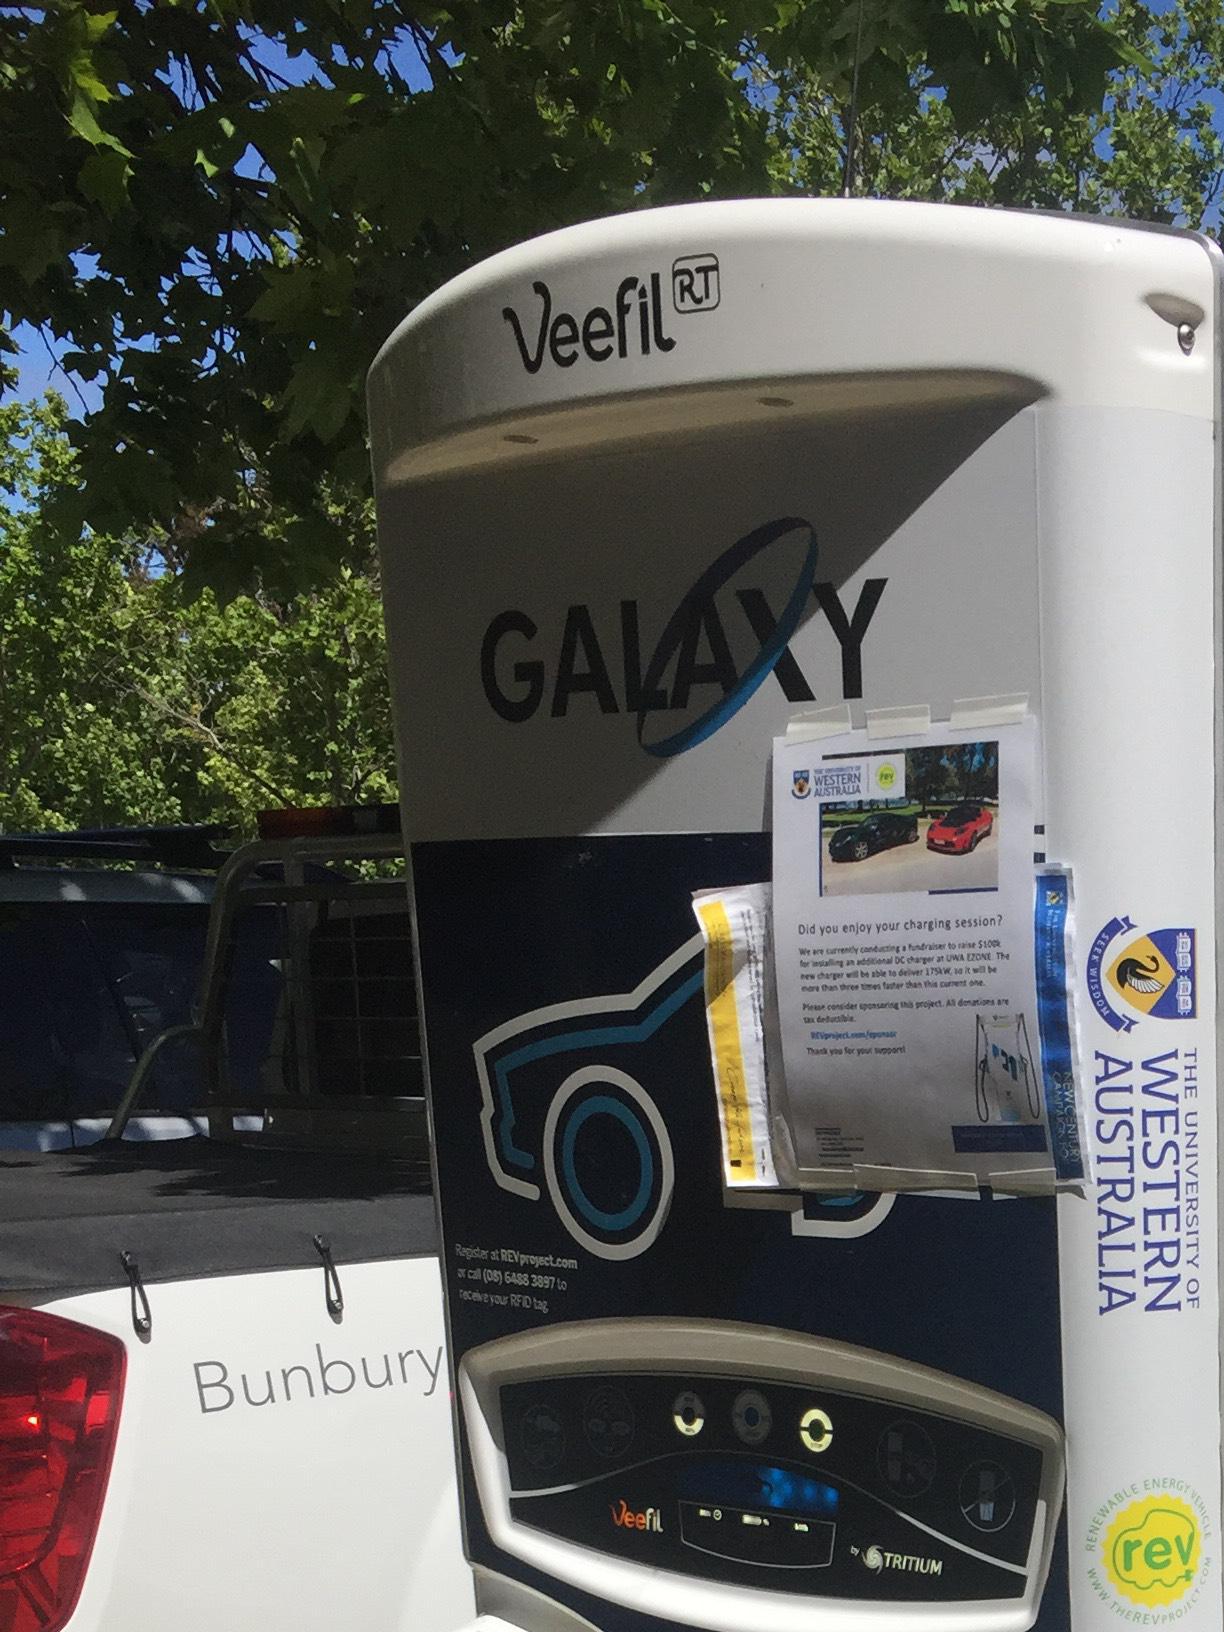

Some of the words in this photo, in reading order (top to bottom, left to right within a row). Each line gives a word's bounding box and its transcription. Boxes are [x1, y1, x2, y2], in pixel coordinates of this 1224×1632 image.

[502, 272, 677, 374] Veefil
[673, 264, 719, 305] RT
[480, 577, 889, 723] GALAXY
[814, 772, 861, 786] WESTERN
[814, 785, 861, 798] AUSTRALIA
[799, 923, 816, 935] Did
[820, 925, 838, 937] you
[842, 923, 872, 936] enjoy
[876, 922, 900, 935] your
[904, 918, 951, 932] charging
[955, 914, 1003, 929] session?
[812, 959, 843, 968] installing
[857, 957, 893, 966] additional
[895, 956, 905, 964] DC
[907, 955, 934, 964] charger
[946, 953, 964, 961] UWA
[996, 952, 1009, 960] The
[826, 946, 859, 955] currently
[860, 945, 900, 954] conducting
[908, 943, 946, 951] fundraiser
[948, 942, 956, 950] to
[958, 941, 976, 949] raise
[1090, 933, 1109, 961] SEEK
[817, 972, 844, 980] charger
[898, 968, 923, 977] deliver
[954, 967, 963, 975] so
[965, 966, 971, 974] it
[972, 965, 986, 974] will
[987, 965, 997, 973] be
[821, 984, 839, 992] than
[840, 983, 859, 991] three
[882, 981, 903, 990] faster
[905, 980, 922, 988] than
[924, 980, 938, 988] this
[940, 979, 966, 988] current
[802, 1003, 825, 1011] Please
[827, 1002, 858, 1010] consider
[859, 1002, 899, 1011] sponsoring
[901, 1001, 914, 1009] this
[946, 999, 956, 1007] All
[957, 998, 995, 1007] donations
[998, 998, 1010, 1006] are
[1089, 967, 1111, 1017] WISDOM
[806, 1047, 828, 1055] Thank
[829, 1048, 843, 1056] you
[844, 1046, 855, 1054] for
[857, 1047, 872, 1056] your
[1062, 1071, 1075, 1104] NEW
[1183, 1047, 1198, 1099] THE
[1065, 1105, 1081, 1162] CENTURY
[1094, 1049, 1137, 1317] AUSTRALIA
[1140, 1048, 1182, 1313] WESTERN
[1184, 1111, 1200, 1270] UNIVERSITY
[455, 1243, 488, 1260] Register
[490, 1249, 500, 1260] at
[500, 1249, 578, 1270] REVproject.com
[457, 1268, 467, 1279] or
[467, 1268, 481, 1281] call
[557, 1277, 568, 1290] to
[1185, 1278, 1200, 1309] OF
[459, 1289, 490, 1303] receive
[490, 1294, 510, 1307] your
[510, 1294, 531, 1309] RFID
[194, 1343, 443, 1414] Bunbury
[610, 1499, 663, 1533] Veefil
[1086, 1483, 1139, 1552] RENEWABLE
[1143, 1477, 1190, 1493] ENERGY
[1190, 1488, 1212, 1541] VEHICLE
[884, 1552, 943, 1575] TRITIUM
[1123, 1532, 1195, 1572] rev
